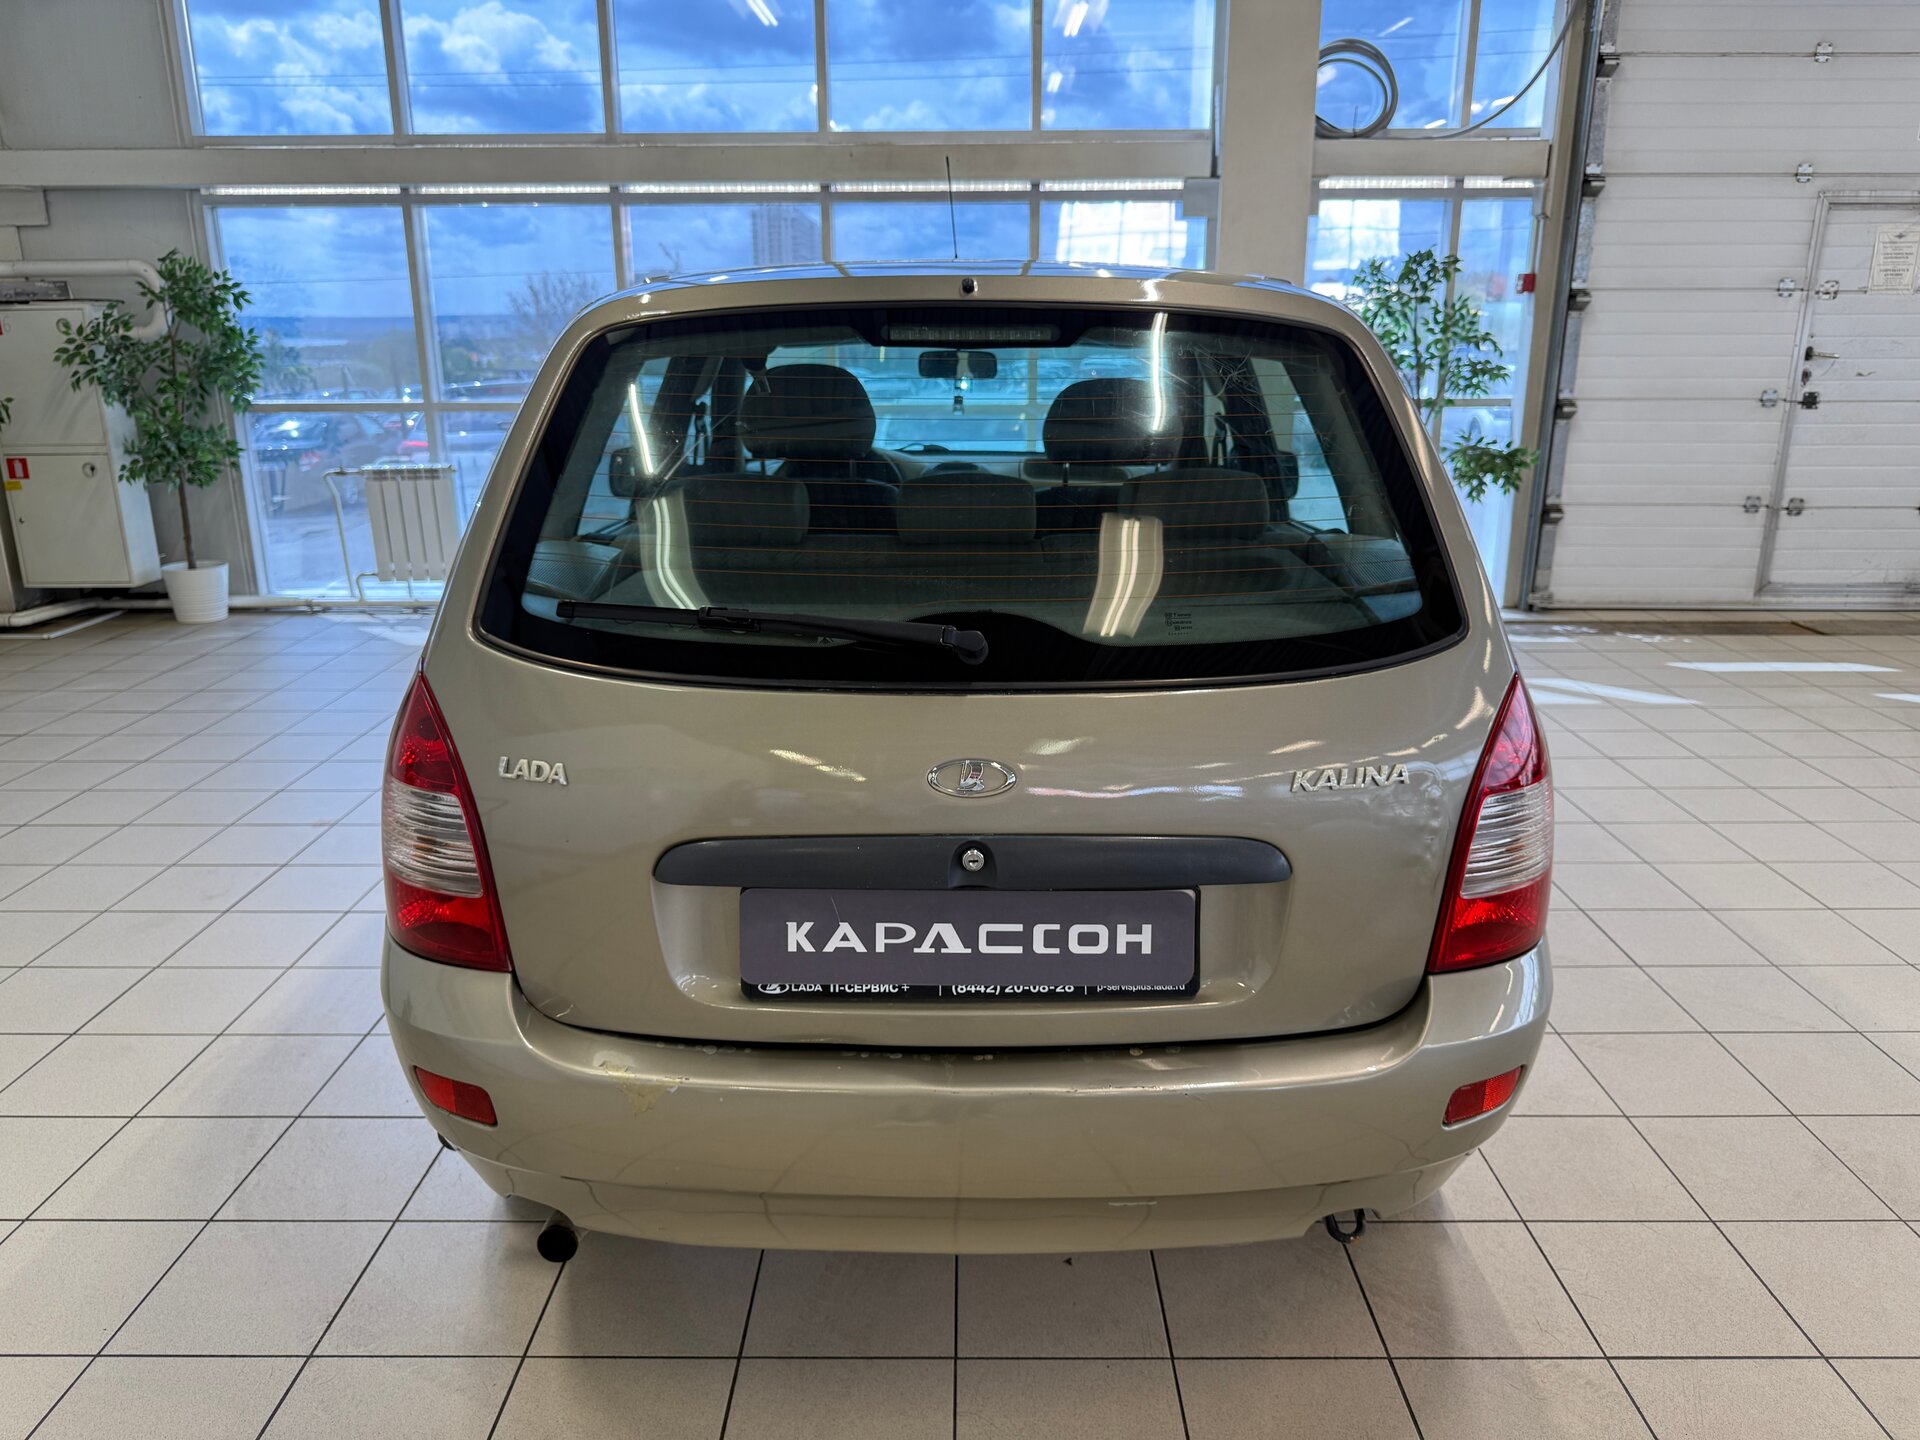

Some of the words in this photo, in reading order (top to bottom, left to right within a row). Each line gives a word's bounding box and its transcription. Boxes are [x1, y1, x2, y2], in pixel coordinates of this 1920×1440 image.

[499, 756, 568, 786] LADA
[1290, 763, 1411, 793] KALINA
[791, 984, 823, 993] LADA
